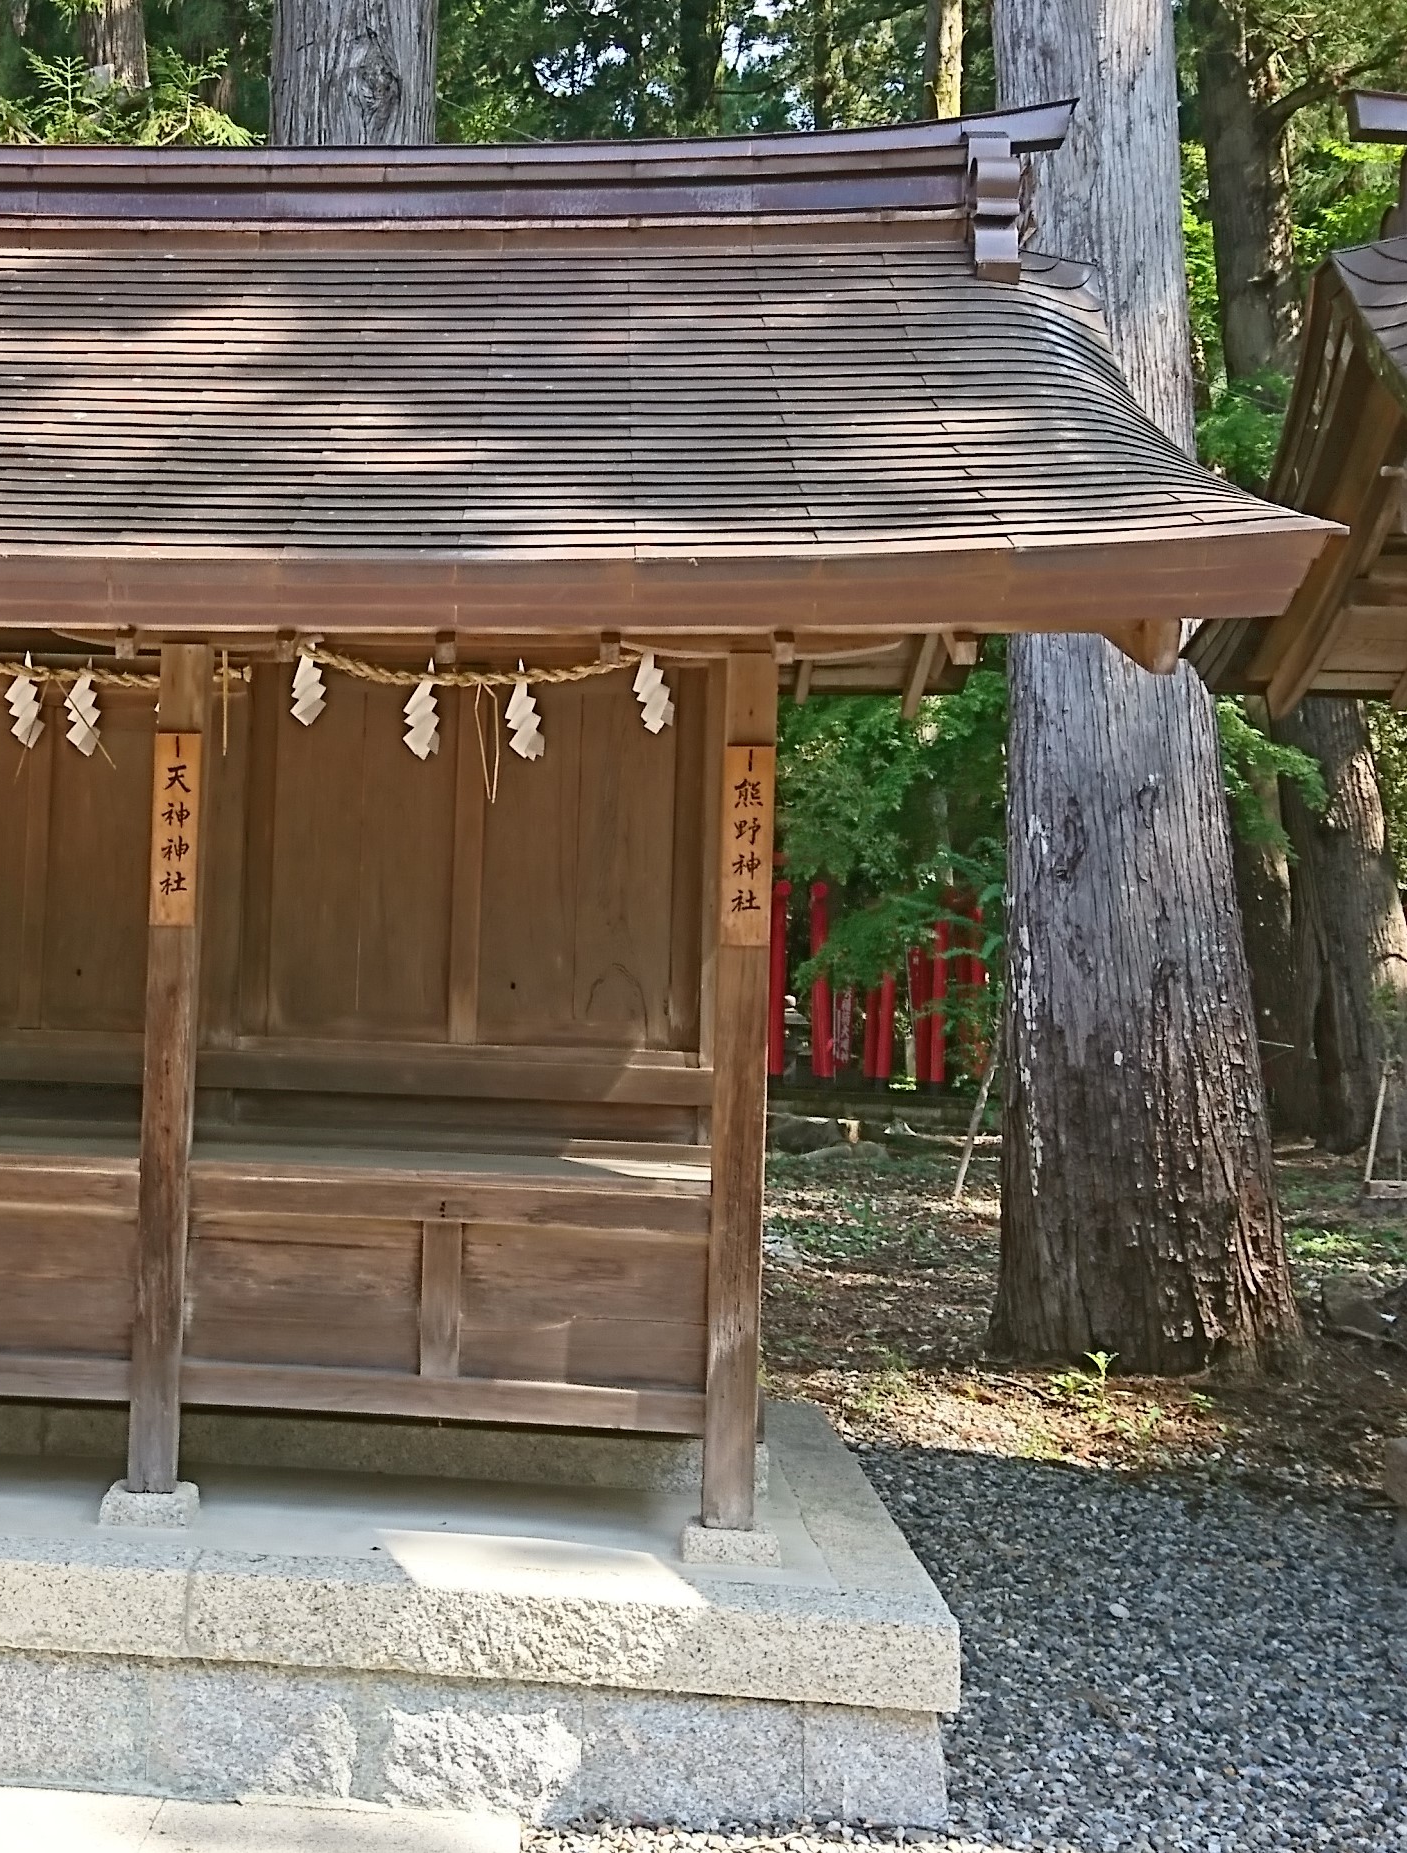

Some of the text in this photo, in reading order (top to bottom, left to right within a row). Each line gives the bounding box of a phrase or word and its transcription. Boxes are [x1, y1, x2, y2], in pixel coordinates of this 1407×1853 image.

[159, 764, 192, 896] 天神神社
[730, 778, 764, 913] 熊野神社
